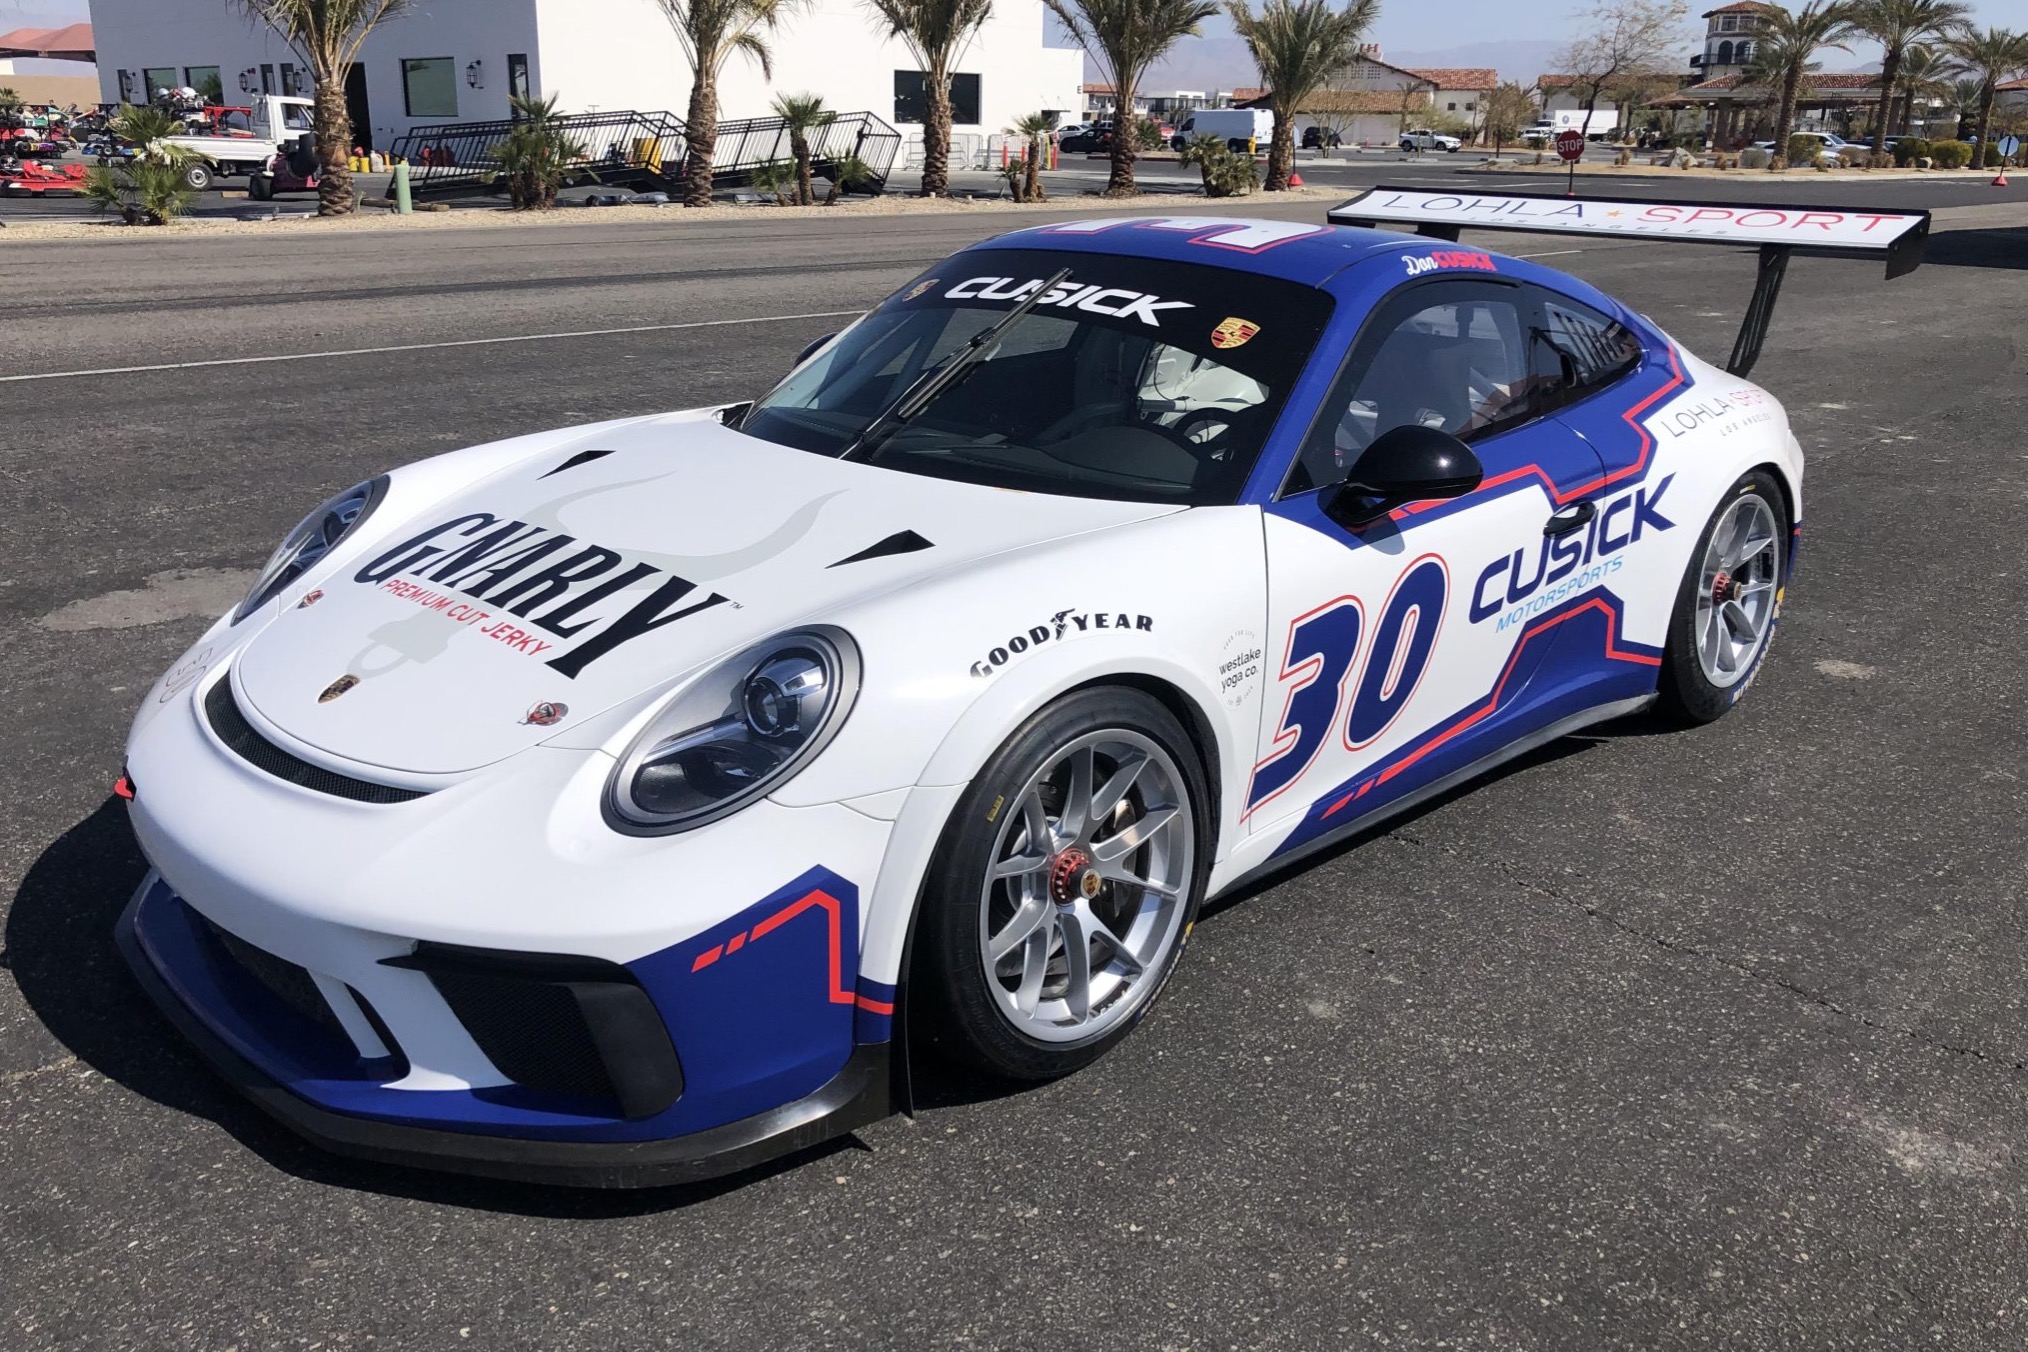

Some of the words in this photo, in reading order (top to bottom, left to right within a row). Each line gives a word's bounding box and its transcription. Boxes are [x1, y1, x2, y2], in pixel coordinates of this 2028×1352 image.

[1558, 138, 1583, 152] STOP
[1382, 194, 1583, 218] LOHLA
[1637, 207, 1904, 232] SPORT
[1401, 255, 1438, 275] Don
[944, 277, 1196, 327] CUSICK
[1660, 397, 1735, 437] LOHLA
[1469, 472, 1677, 624] CUSICK
[353, 512, 731, 680] GNARLY
[1495, 555, 1624, 633] MOTORSPORTS
[379, 579, 454, 611] PREMIUM
[447, 604, 491, 626] CUT
[480, 622, 553, 656] JERKY
[1219, 648, 1261, 675] westlake
[1221, 671, 1243, 694] yoga
[1239, 553, 1450, 824] 30
